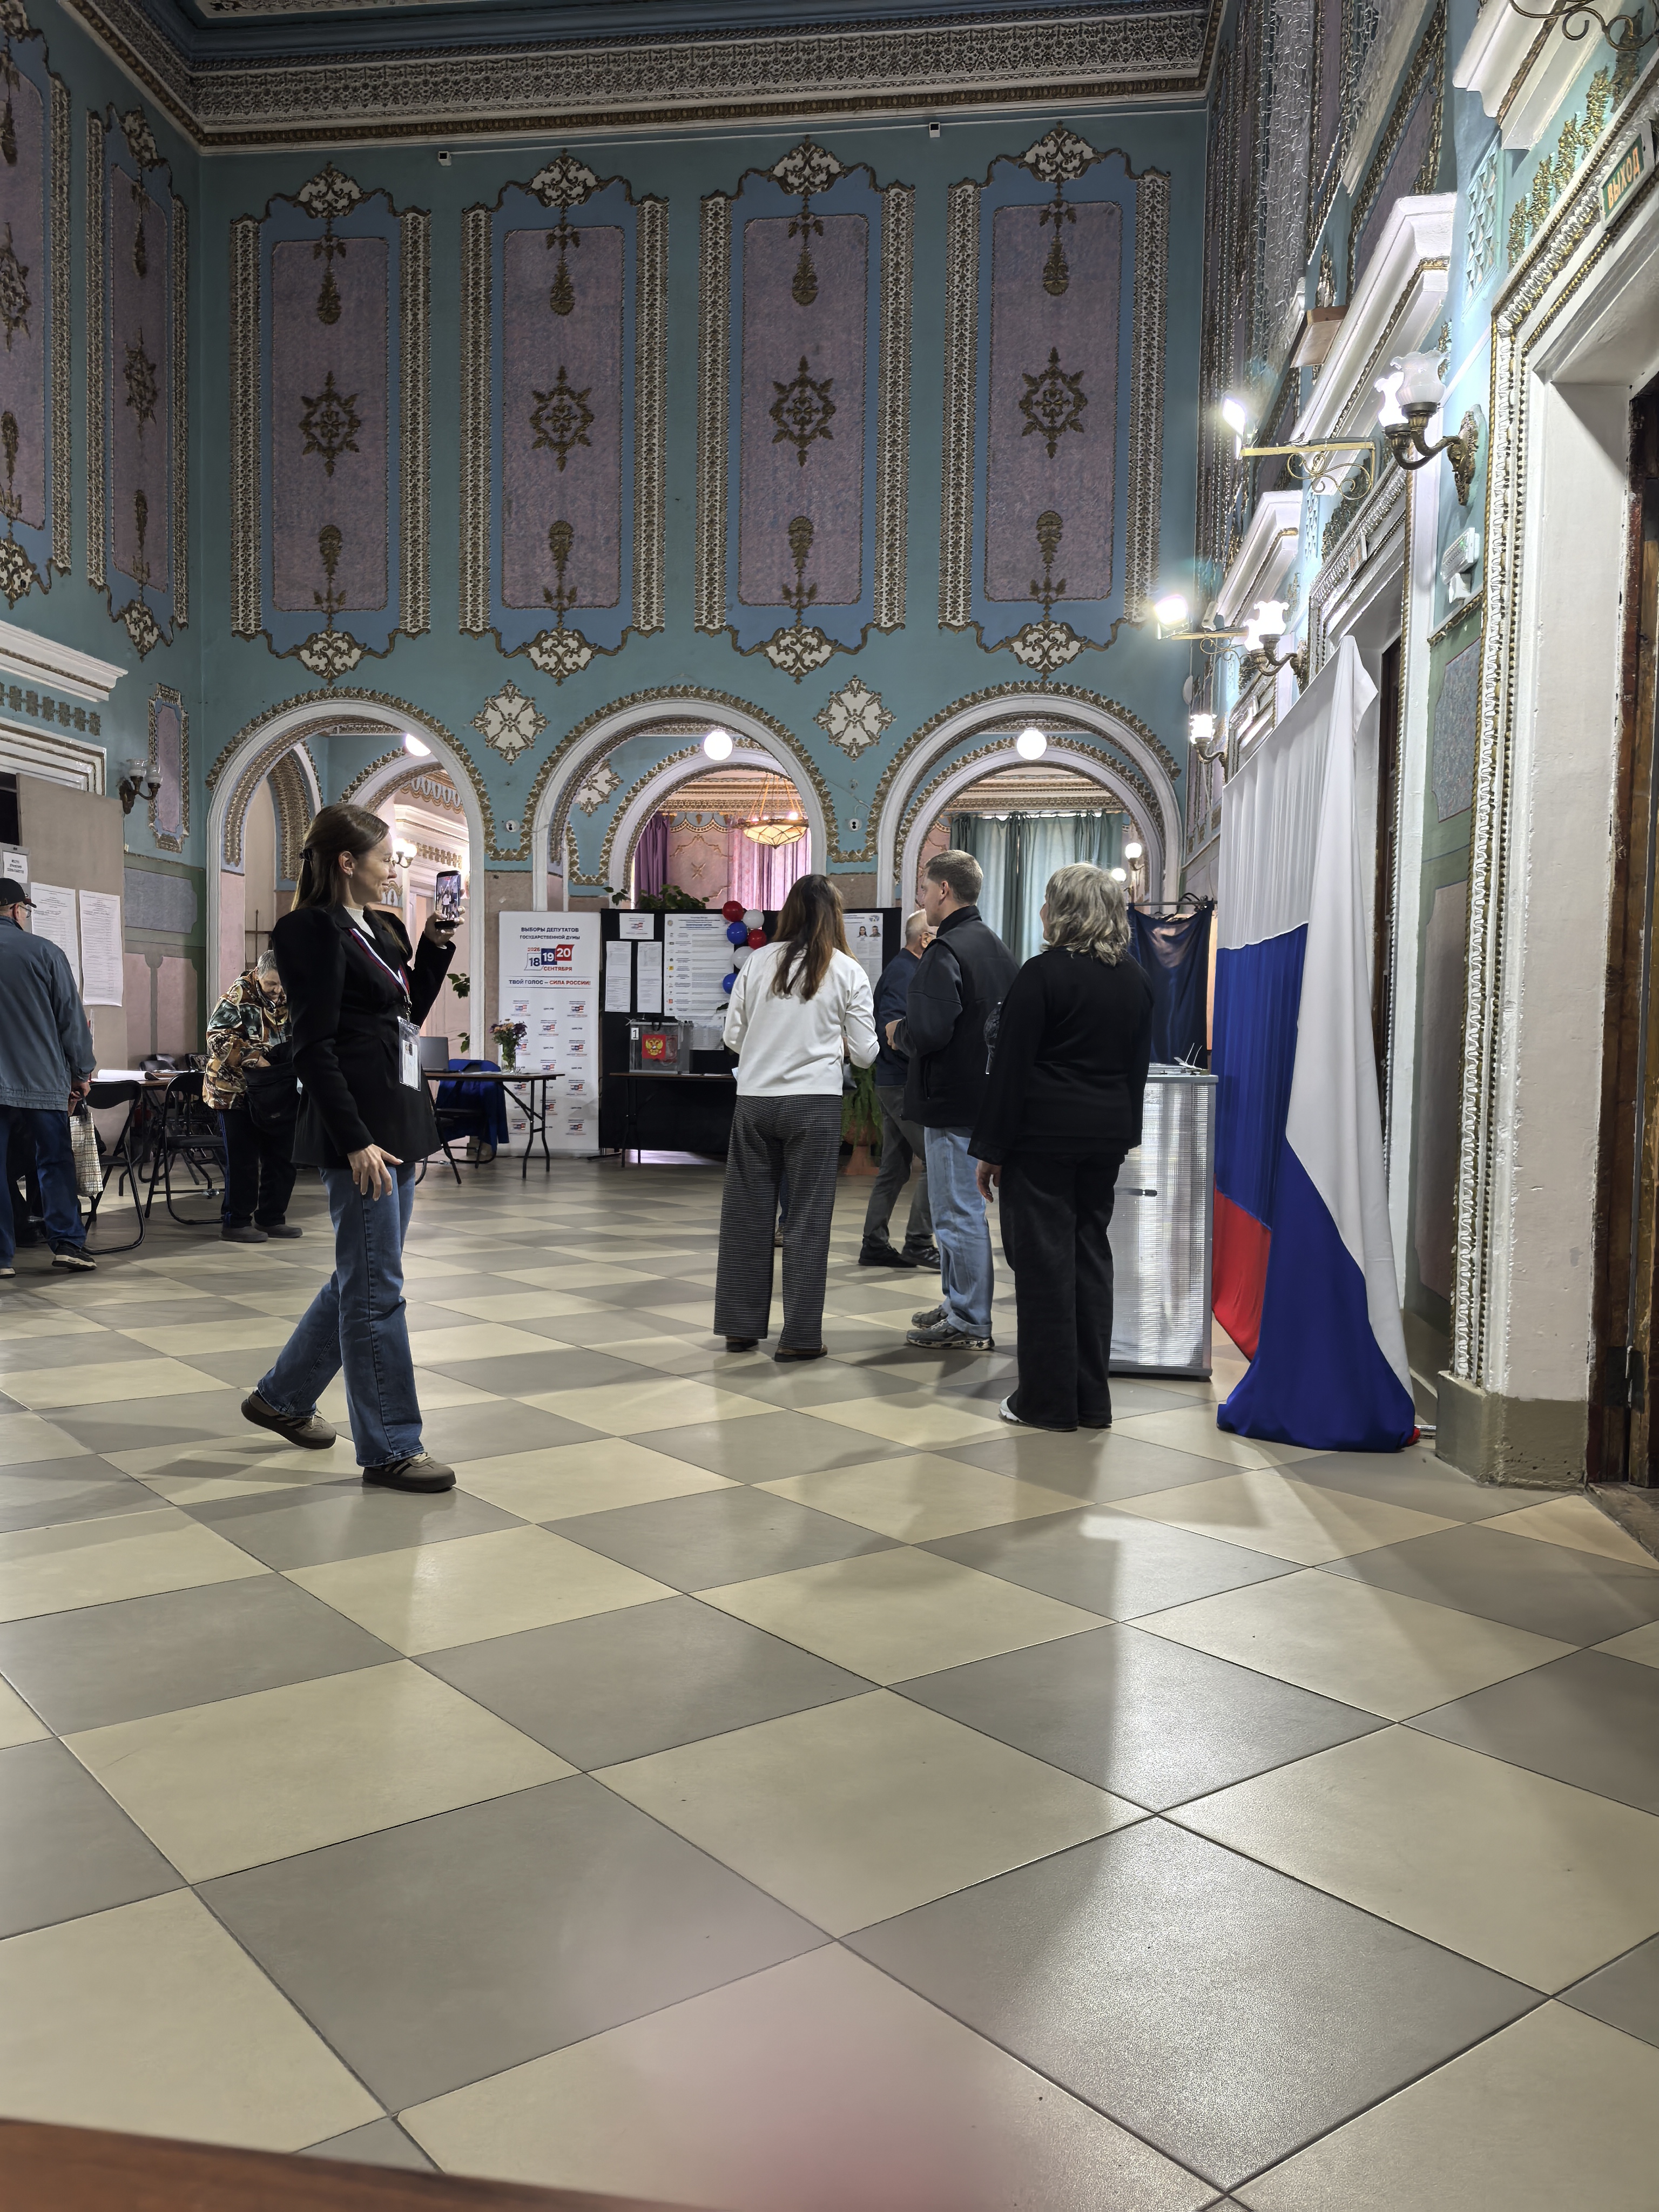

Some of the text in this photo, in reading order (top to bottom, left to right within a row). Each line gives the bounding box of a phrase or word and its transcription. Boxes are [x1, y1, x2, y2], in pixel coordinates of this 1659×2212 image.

[1607, 146, 1640, 210] ВЫХОД
[529, 948, 571, 967] 18 19 20
[633, 1029, 638, 1038] 1
